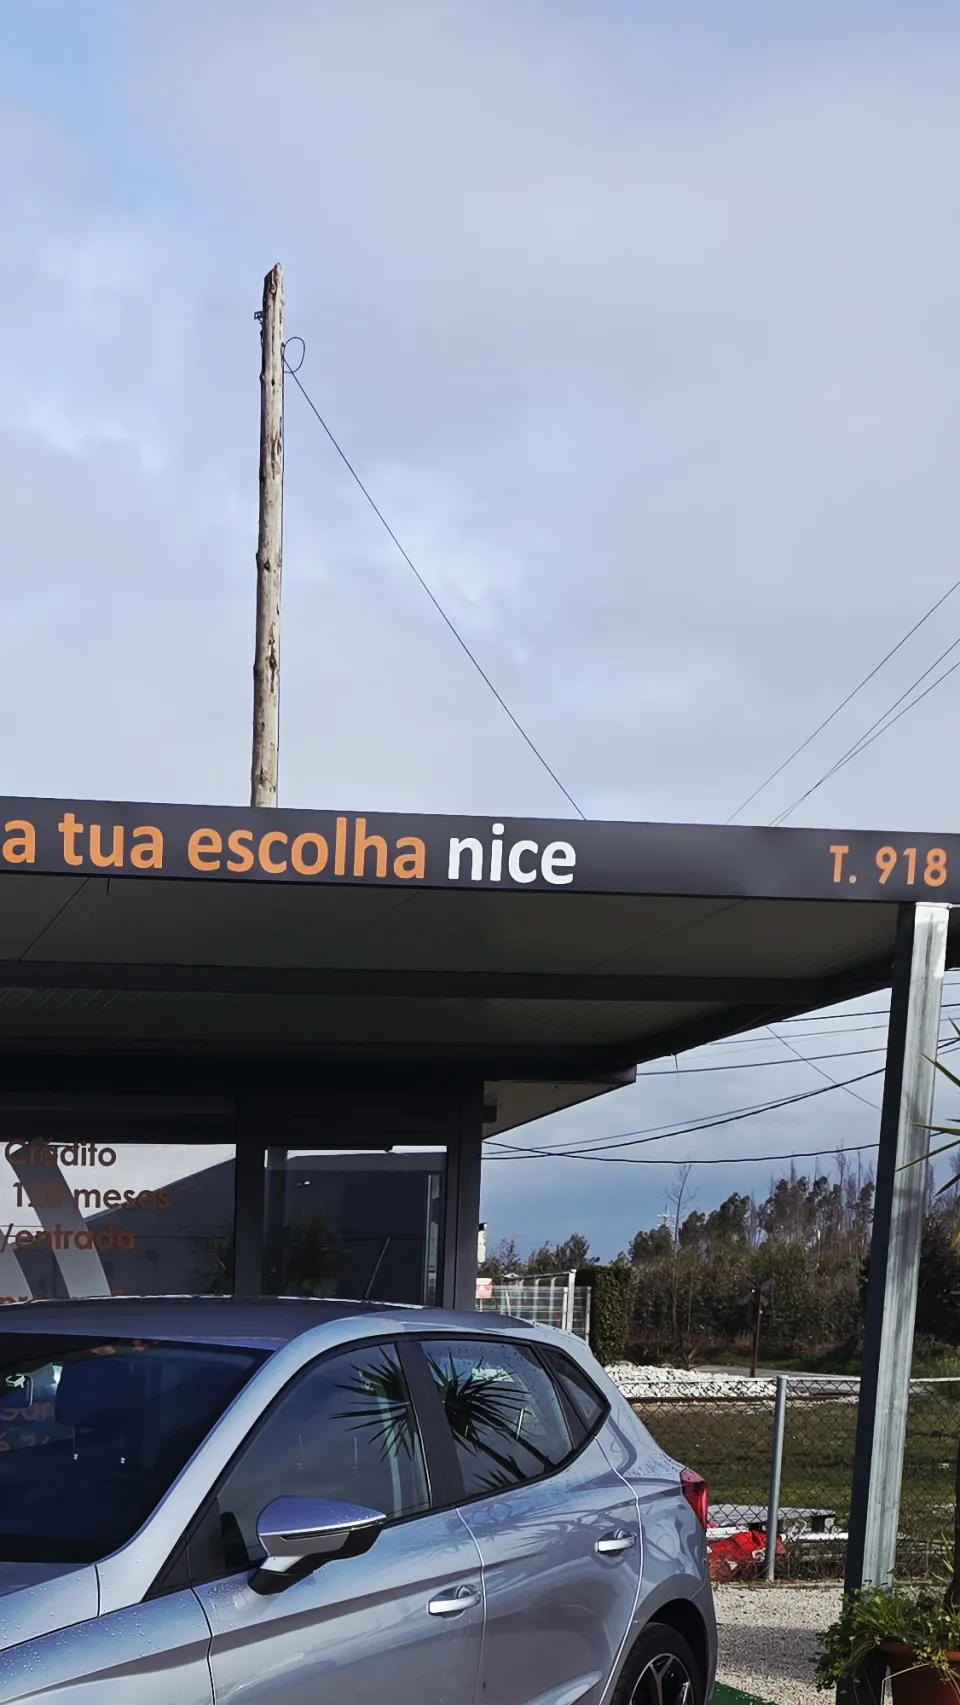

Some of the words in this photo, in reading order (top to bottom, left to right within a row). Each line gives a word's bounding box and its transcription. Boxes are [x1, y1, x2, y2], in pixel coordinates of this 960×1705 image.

[1, 818, 36, 865] a
[58, 812, 165, 869] tua
[186, 816, 427, 880] escolha
[446, 822, 578, 885] nice
[829, 844, 858, 884] T.
[875, 845, 948, 887] 918
[4, 1136, 117, 1168] Crédito
[12, 1181, 65, 1209] 120
[73, 1187, 172, 1211] meses
